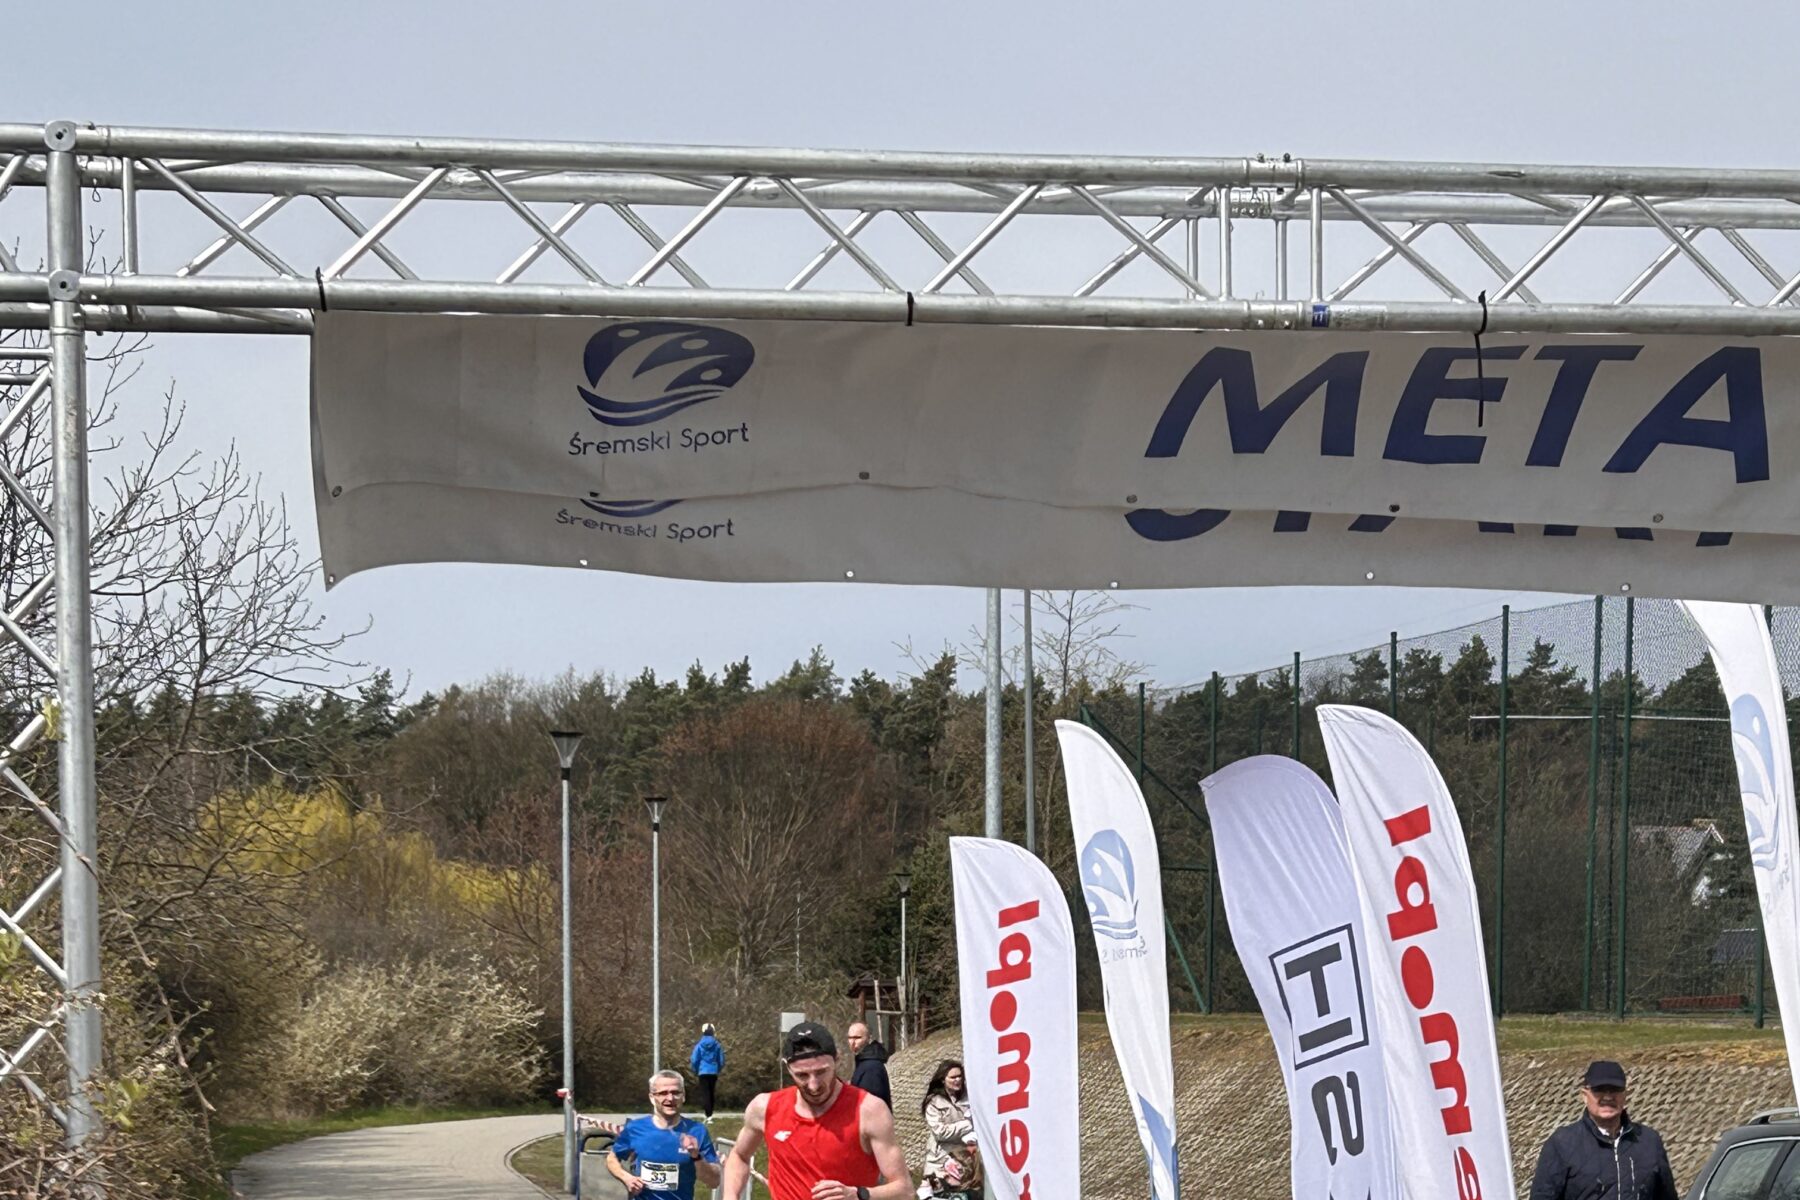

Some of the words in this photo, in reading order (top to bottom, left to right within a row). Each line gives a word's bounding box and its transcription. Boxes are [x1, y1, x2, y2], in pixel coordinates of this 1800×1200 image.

[1145, 344, 1769, 484] META
[568, 431, 671, 456] Śremski
[680, 422, 750, 453] Sport
[667, 518, 735, 544] Sport
[651, 1171, 667, 1184] 33
